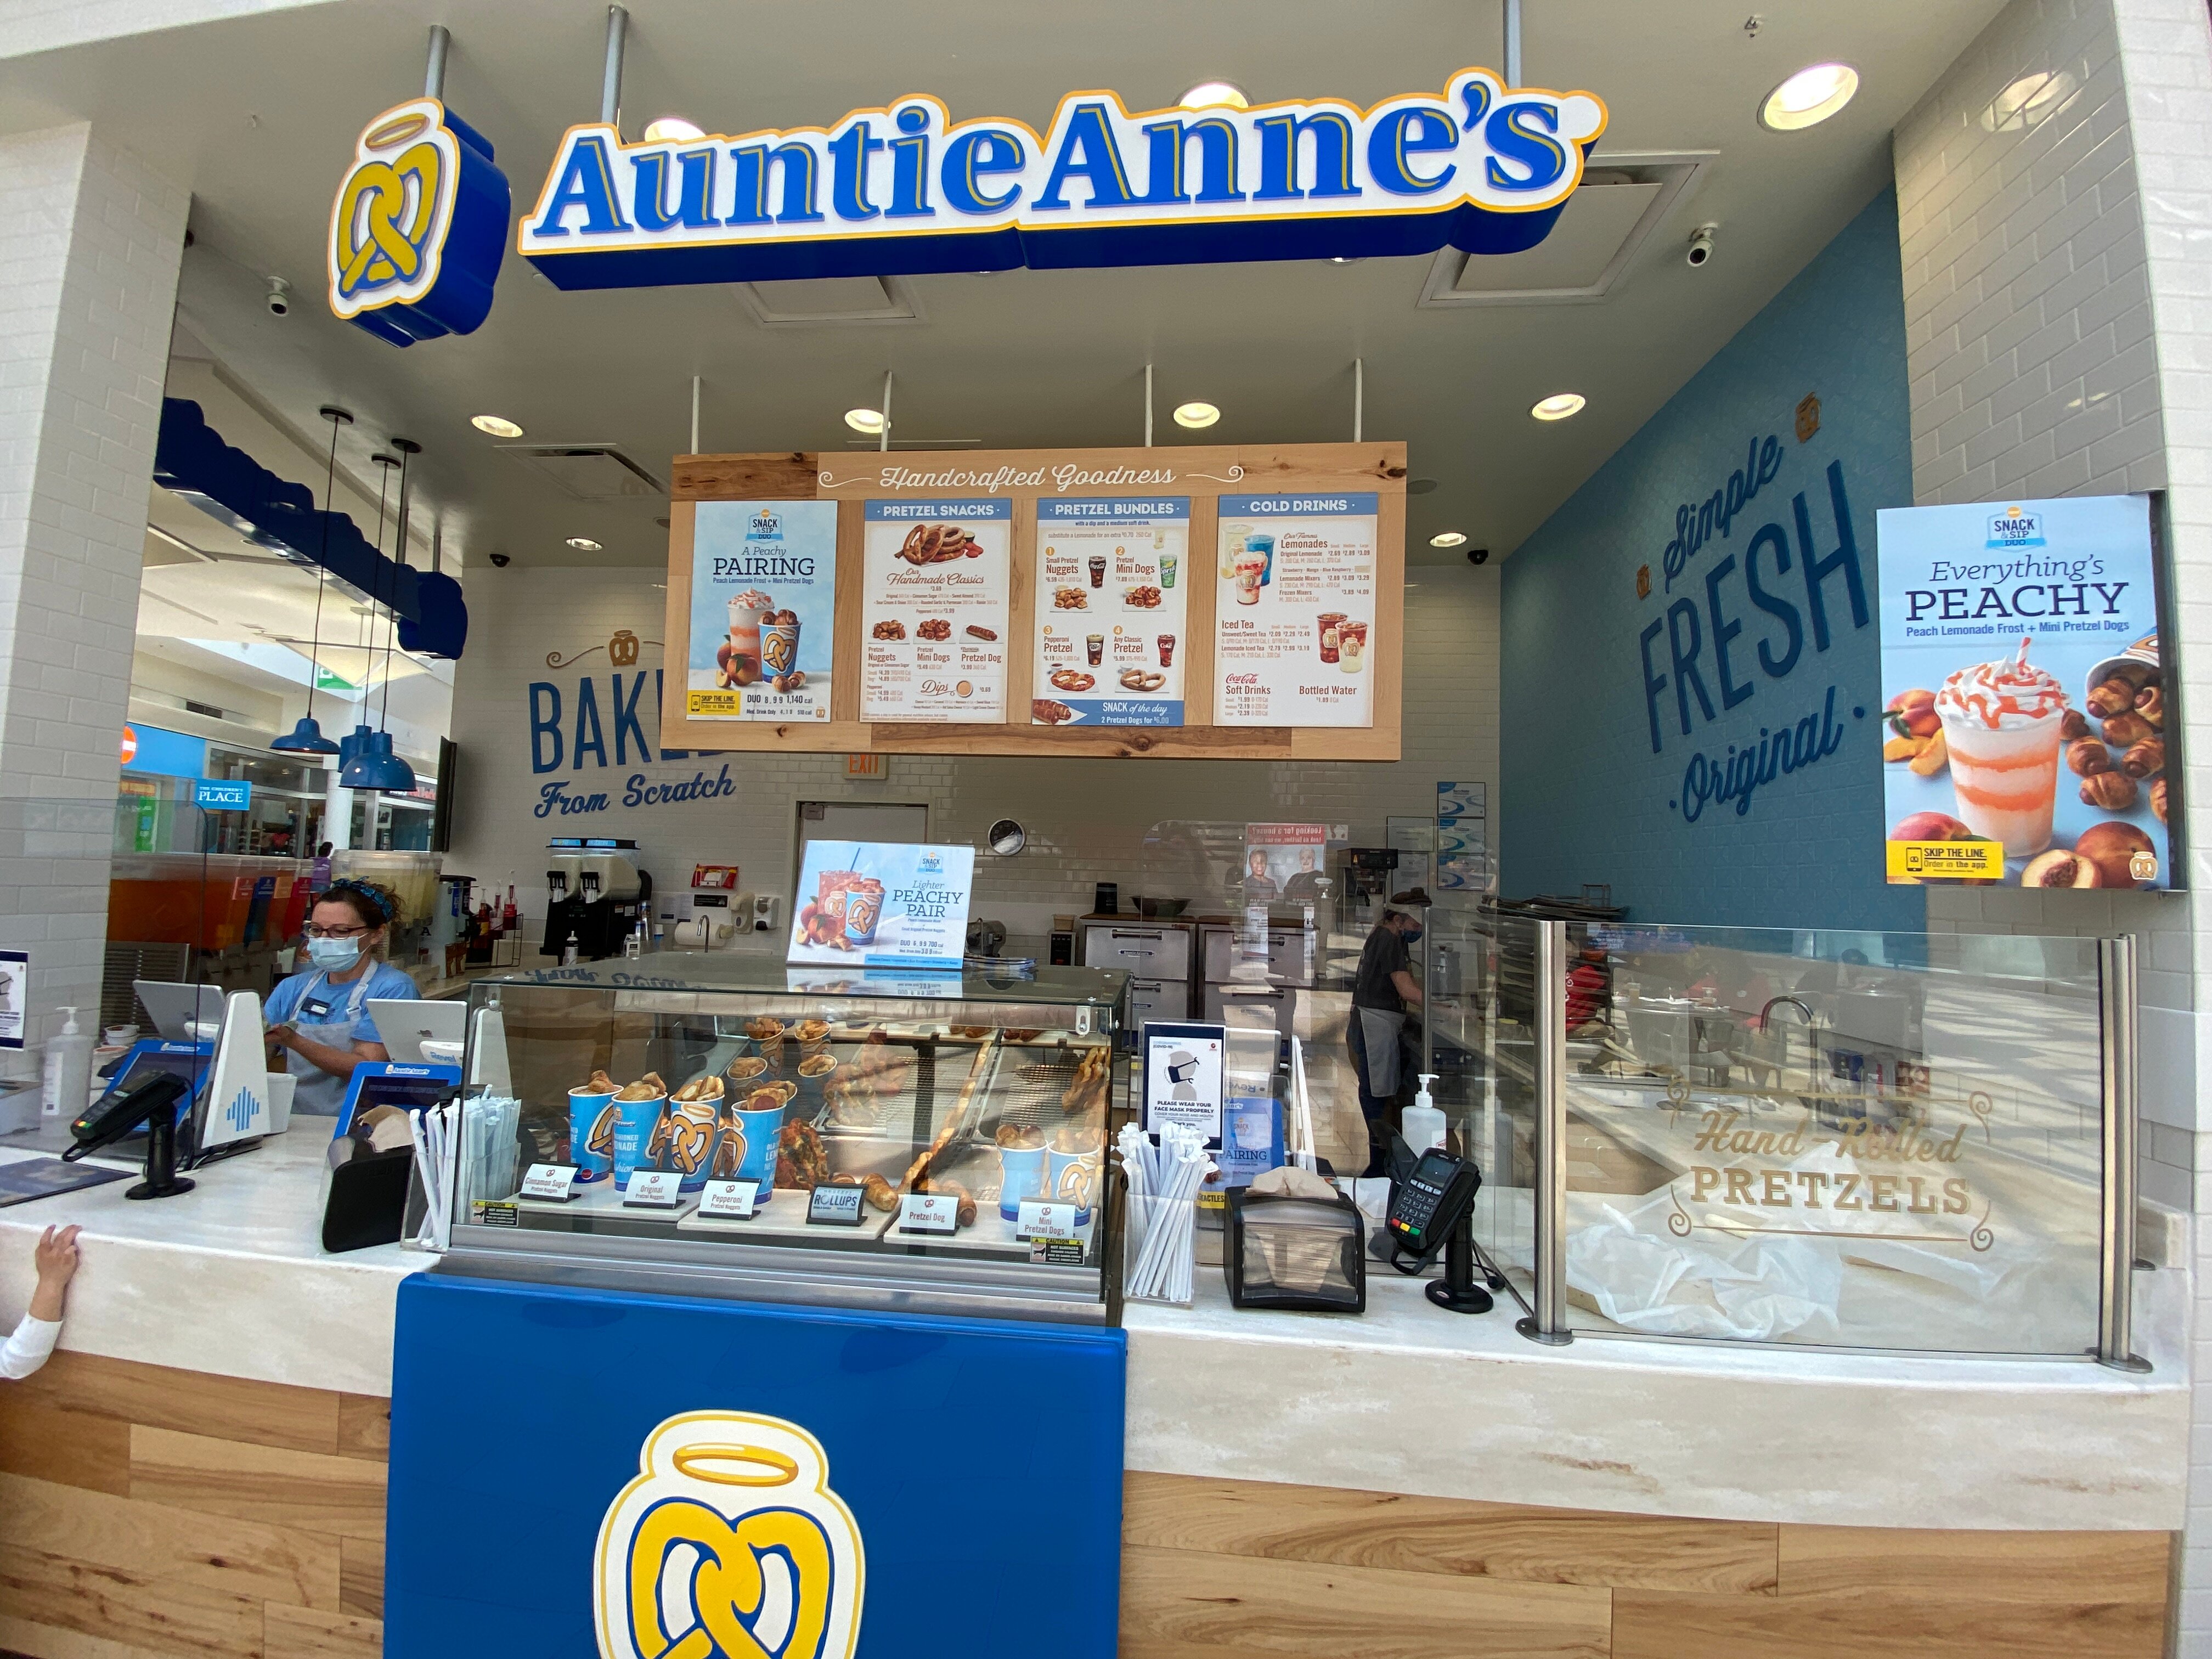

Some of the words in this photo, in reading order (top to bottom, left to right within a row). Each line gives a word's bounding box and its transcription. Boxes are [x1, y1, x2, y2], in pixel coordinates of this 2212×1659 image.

[532, 104, 1024, 237] Auntie
[1030, 80, 1567, 213] Anne's
[879, 466, 1046, 493] Handcrafted
[1052, 464, 1176, 492] Goodness
[883, 505, 937, 516] PRETZEL
[940, 505, 994, 516] SNACKS
[1056, 504, 1111, 515] PRETZEL
[1114, 503, 1174, 515] BUNDLES
[1250, 500, 1290, 512] COLD
[1293, 499, 1347, 511] DRINKS
[1663, 434, 1785, 594] Simple
[753, 518, 777, 528] SNACK
[1994, 518, 2035, 532] SNACK
[2010, 530, 2029, 539] SIP
[1281, 539, 1328, 549] Lemonades
[2005, 539, 2026, 547] DUO
[741, 546, 750, 555] A
[753, 546, 786, 557] Peachy
[713, 557, 815, 575] PAIRING
[905, 567, 919, 575] Our
[1046, 565, 1079, 575] Nuggets
[1116, 565, 1133, 573] Mini
[1135, 564, 1155, 574] Dogs
[1929, 554, 2104, 584] Everything's
[887, 572, 946, 585] Handmade
[947, 572, 984, 585] Classics
[1640, 459, 1869, 753] FRESH
[1905, 582, 2129, 621] PEACHY
[1222, 620, 1239, 629] Iced
[1240, 620, 1254, 629] Tea
[1906, 626, 1938, 637] Peach
[1942, 624, 1994, 636] Lemonade
[1997, 623, 2024, 634] Frost
[2039, 622, 2061, 632] Mini
[2063, 620, 2101, 631] Pretzel
[2104, 619, 2129, 632] Dogs
[1044, 643, 1073, 652] Pretzel
[1114, 644, 1143, 652] Pretzel
[868, 653, 896, 662] Nuggets
[917, 653, 932, 661] Mini
[933, 653, 950, 663] Dogs
[961, 653, 986, 662] Pretzel
[988, 654, 1001, 663] Dog
[920, 679, 949, 695] Dips
[1226, 686, 1242, 694] Soft
[1244, 686, 1271, 695] Drinks
[1299, 686, 1329, 695] Bottled
[1331, 686, 1357, 695] Water
[747, 695, 761, 703] DUO
[787, 695, 803, 704] 1,140
[1103, 702, 1127, 712] SNACK
[1129, 705, 1137, 714] of
[1137, 703, 1151, 712] the
[1152, 703, 1167, 715] day
[1682, 685, 1844, 823] Original
[198, 791, 244, 803] PLACE
[534, 781, 610, 819] From
[622, 764, 736, 808] Scratch
[1924, 848, 1944, 857] SKIP
[1947, 848, 1963, 857] THE
[1966, 849, 1987, 857] LINE.
[912, 880, 945, 890] Lighter
[892, 889, 963, 904] PEACHY
[906, 904, 945, 917] PAIR
[525, 1177, 551, 1186] Cinnamon
[552, 1180, 568, 1188] Sugar
[640, 1184, 663, 1194] Original
[1690, 1165, 1970, 1215] PRETZELS
[712, 1193, 743, 1204] Pepperoni
[814, 1194, 857, 1206] ROLLUPS
[909, 1211, 932, 1222] Pretzel
[933, 1212, 945, 1223] Dog
[1039, 1217, 1052, 1225] Mini
[1024, 1224, 1047, 1233] Pretzel
[1049, 1226, 1065, 1235] Dogs
